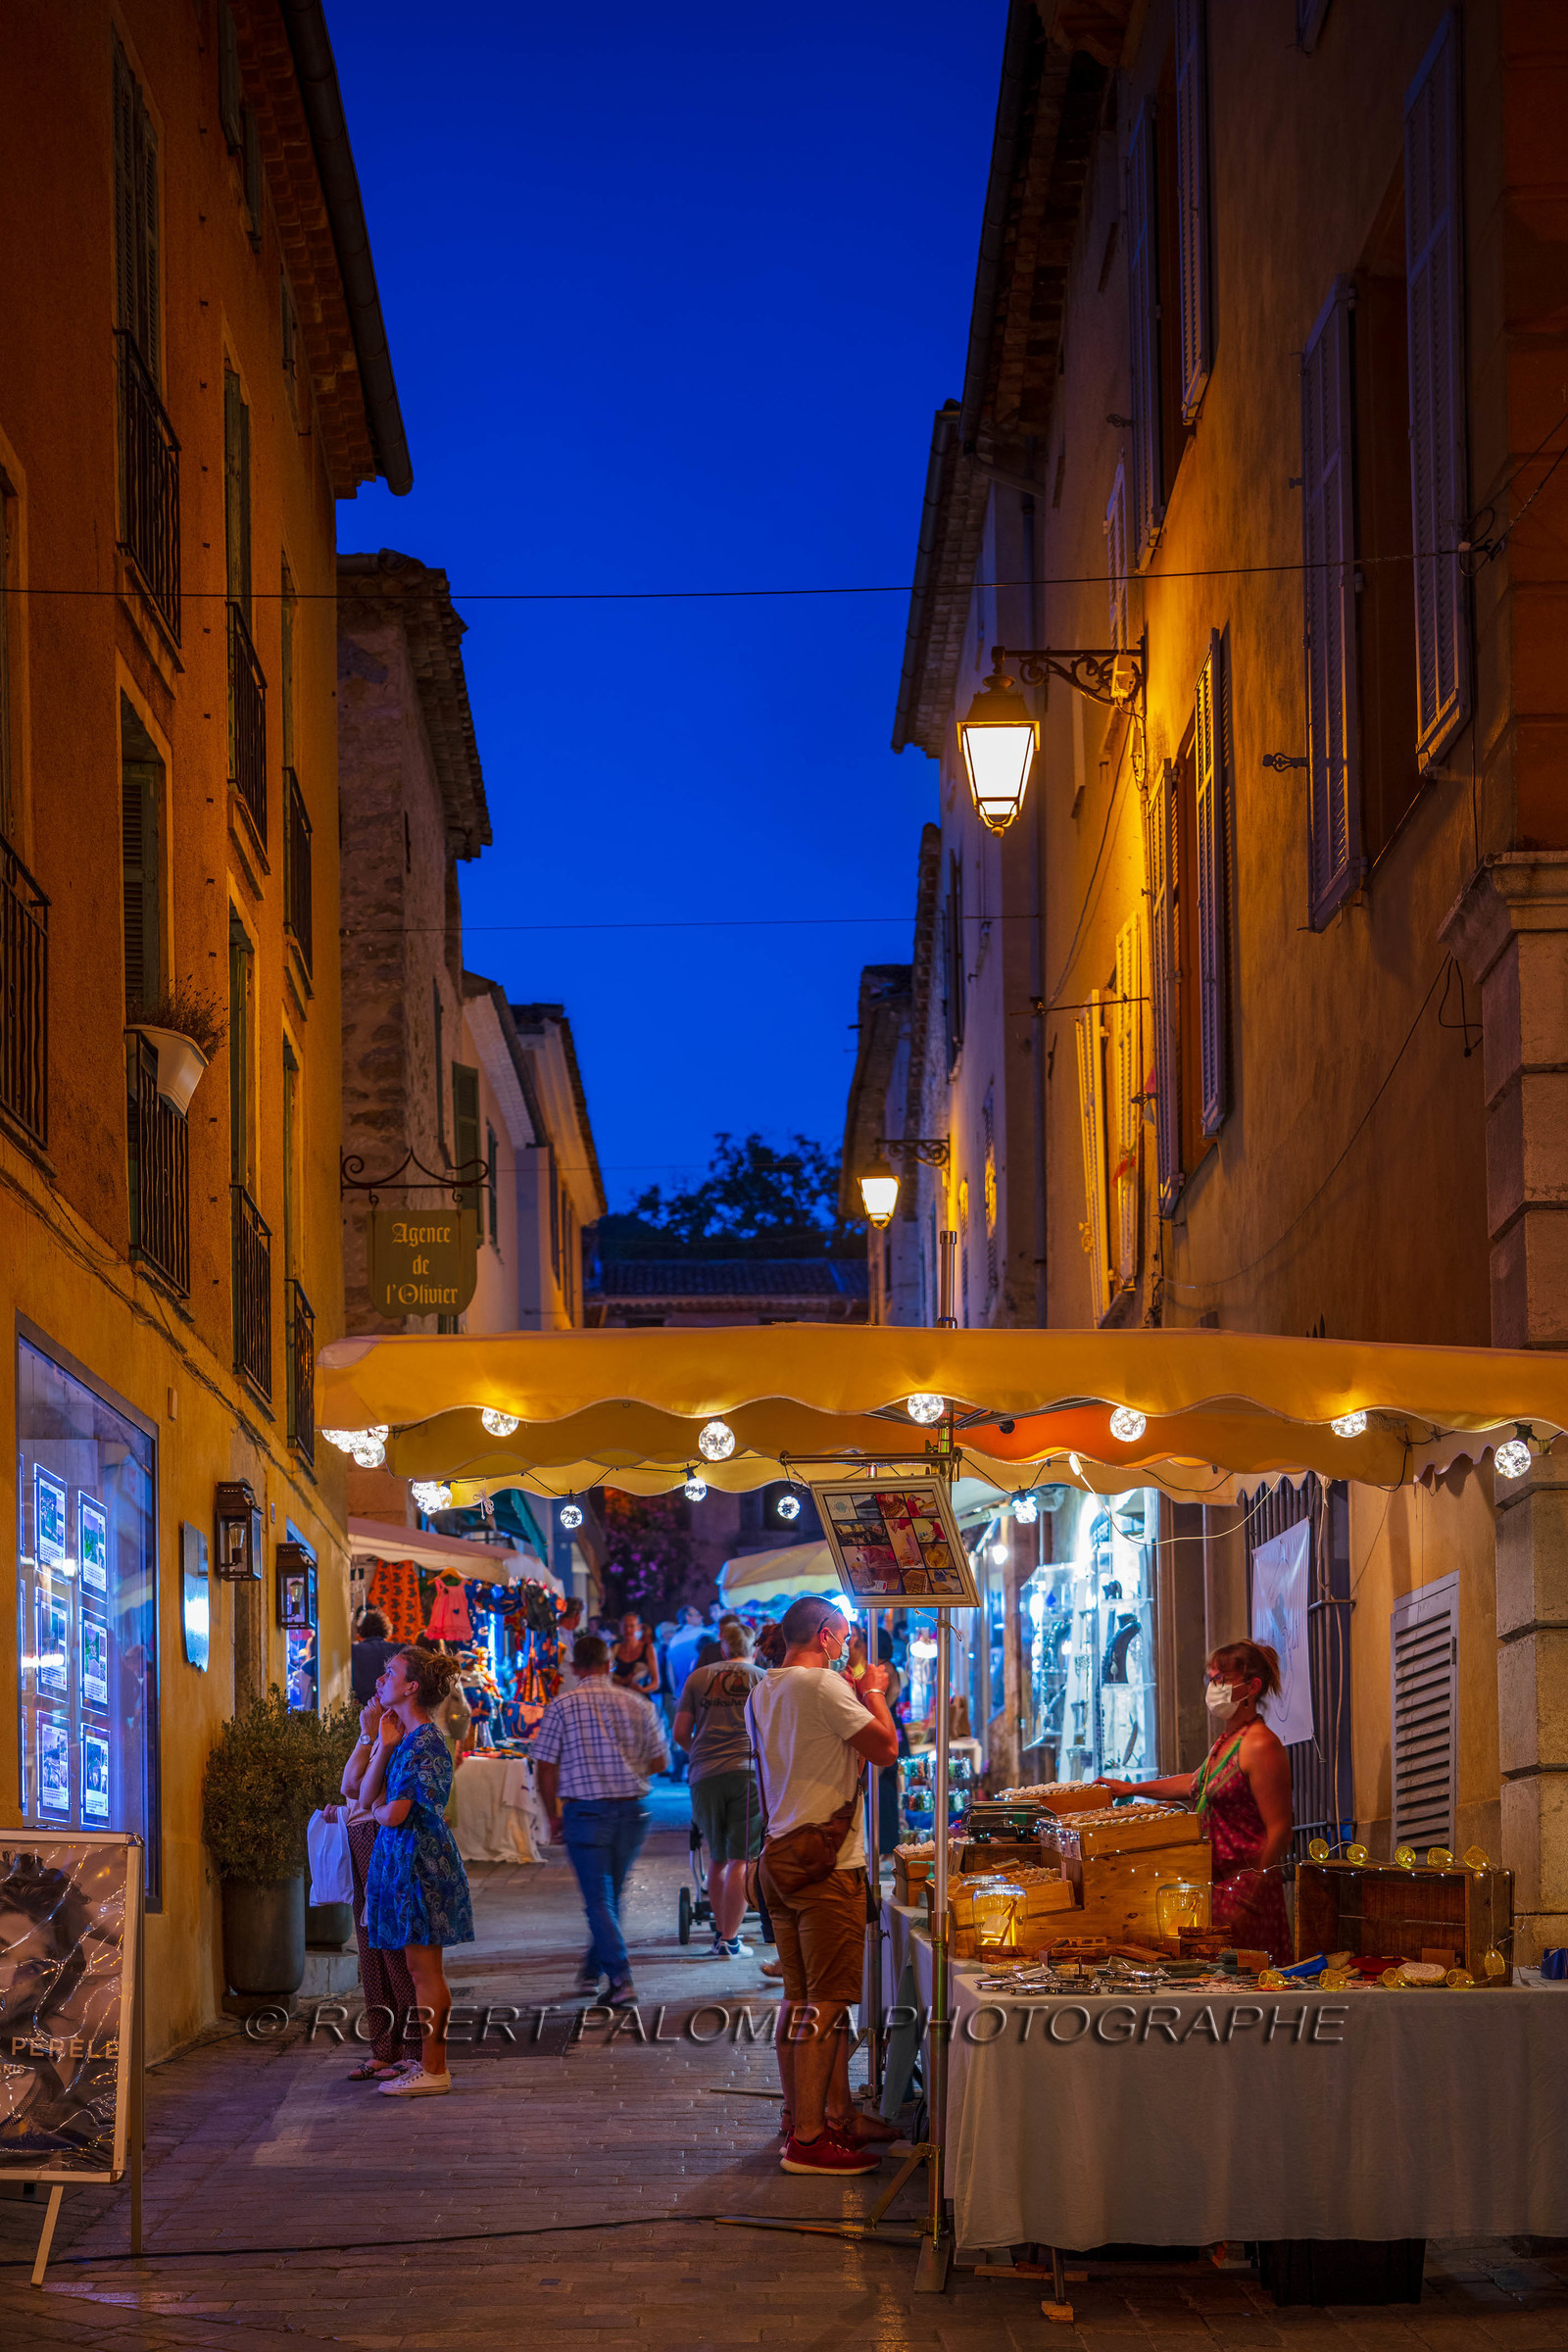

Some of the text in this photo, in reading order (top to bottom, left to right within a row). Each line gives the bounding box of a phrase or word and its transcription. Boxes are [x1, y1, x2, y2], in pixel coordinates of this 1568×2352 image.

[392, 1223, 451, 1248] Agence
[412, 1254, 430, 1275] de
[386, 1283, 459, 1305] l'Olivier
[0, 2063, 25, 2076] RIS
